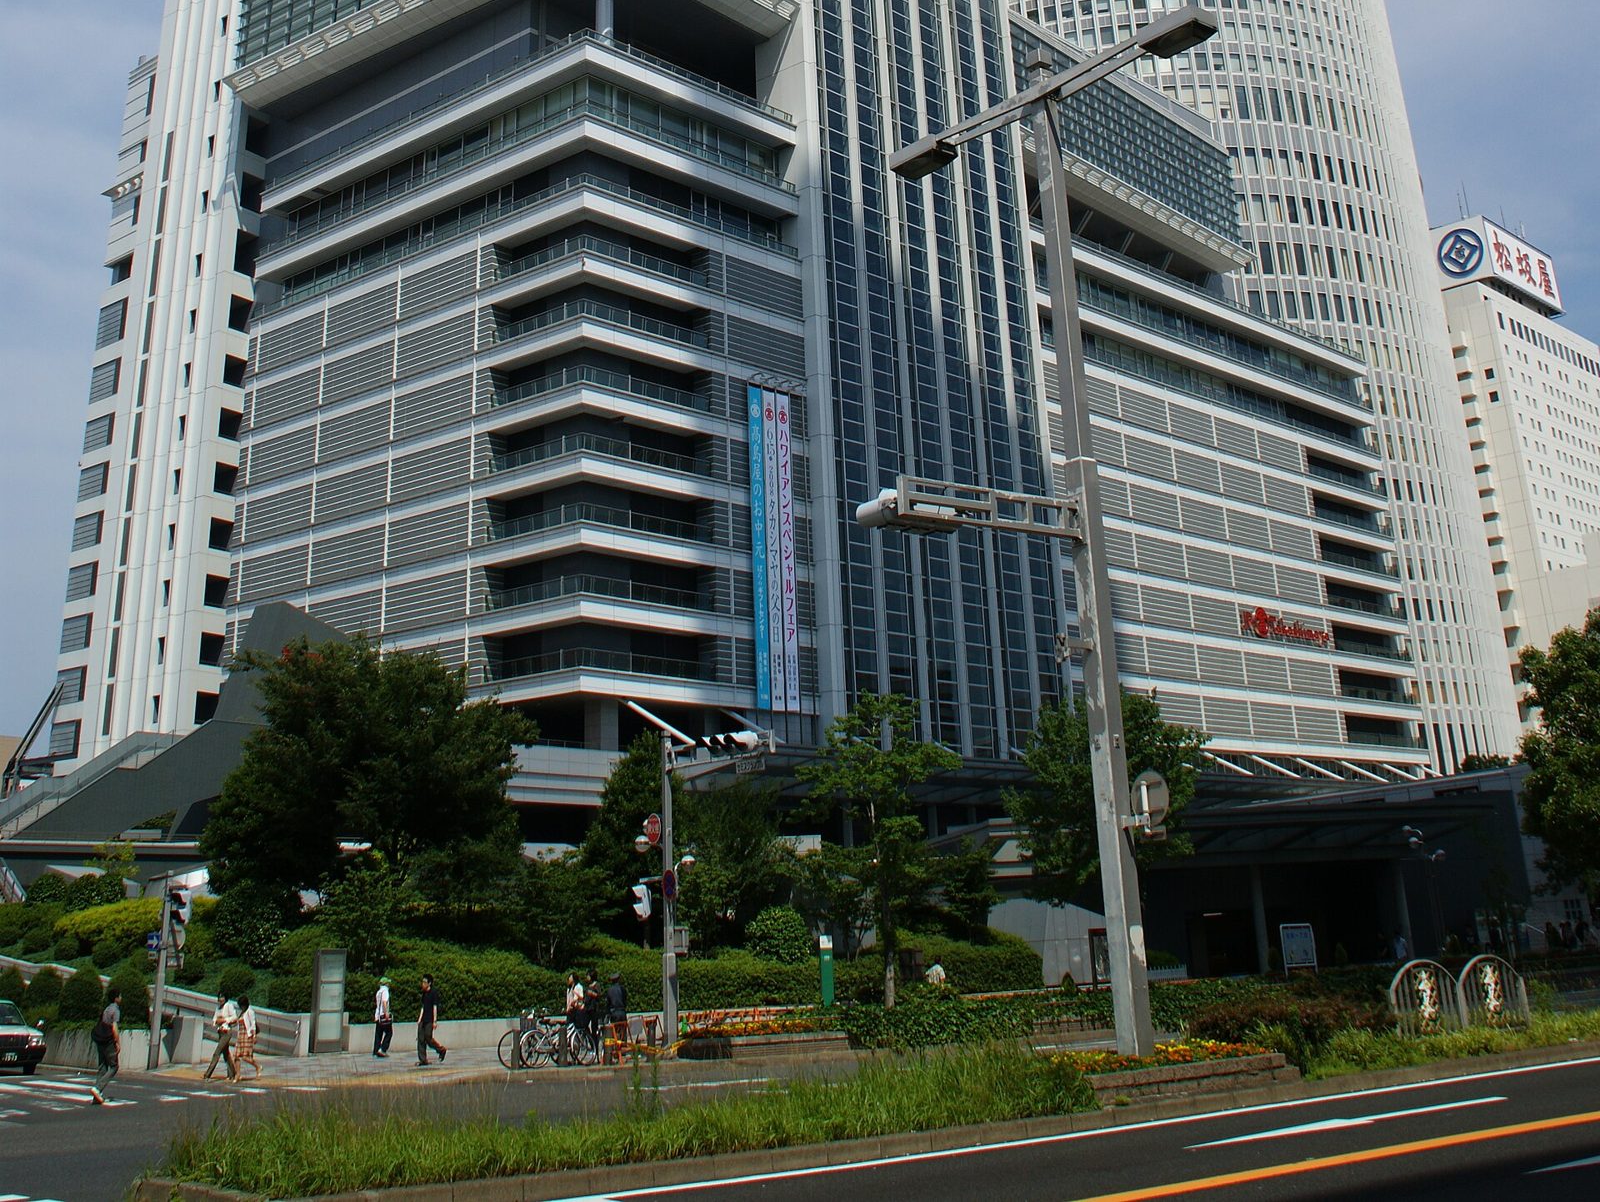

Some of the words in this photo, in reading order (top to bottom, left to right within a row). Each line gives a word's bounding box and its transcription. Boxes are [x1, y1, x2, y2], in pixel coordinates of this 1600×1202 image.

[1492, 229, 1556, 299] 松坂屋
[780, 430, 795, 643] ハワイアンスペシャルフェア
